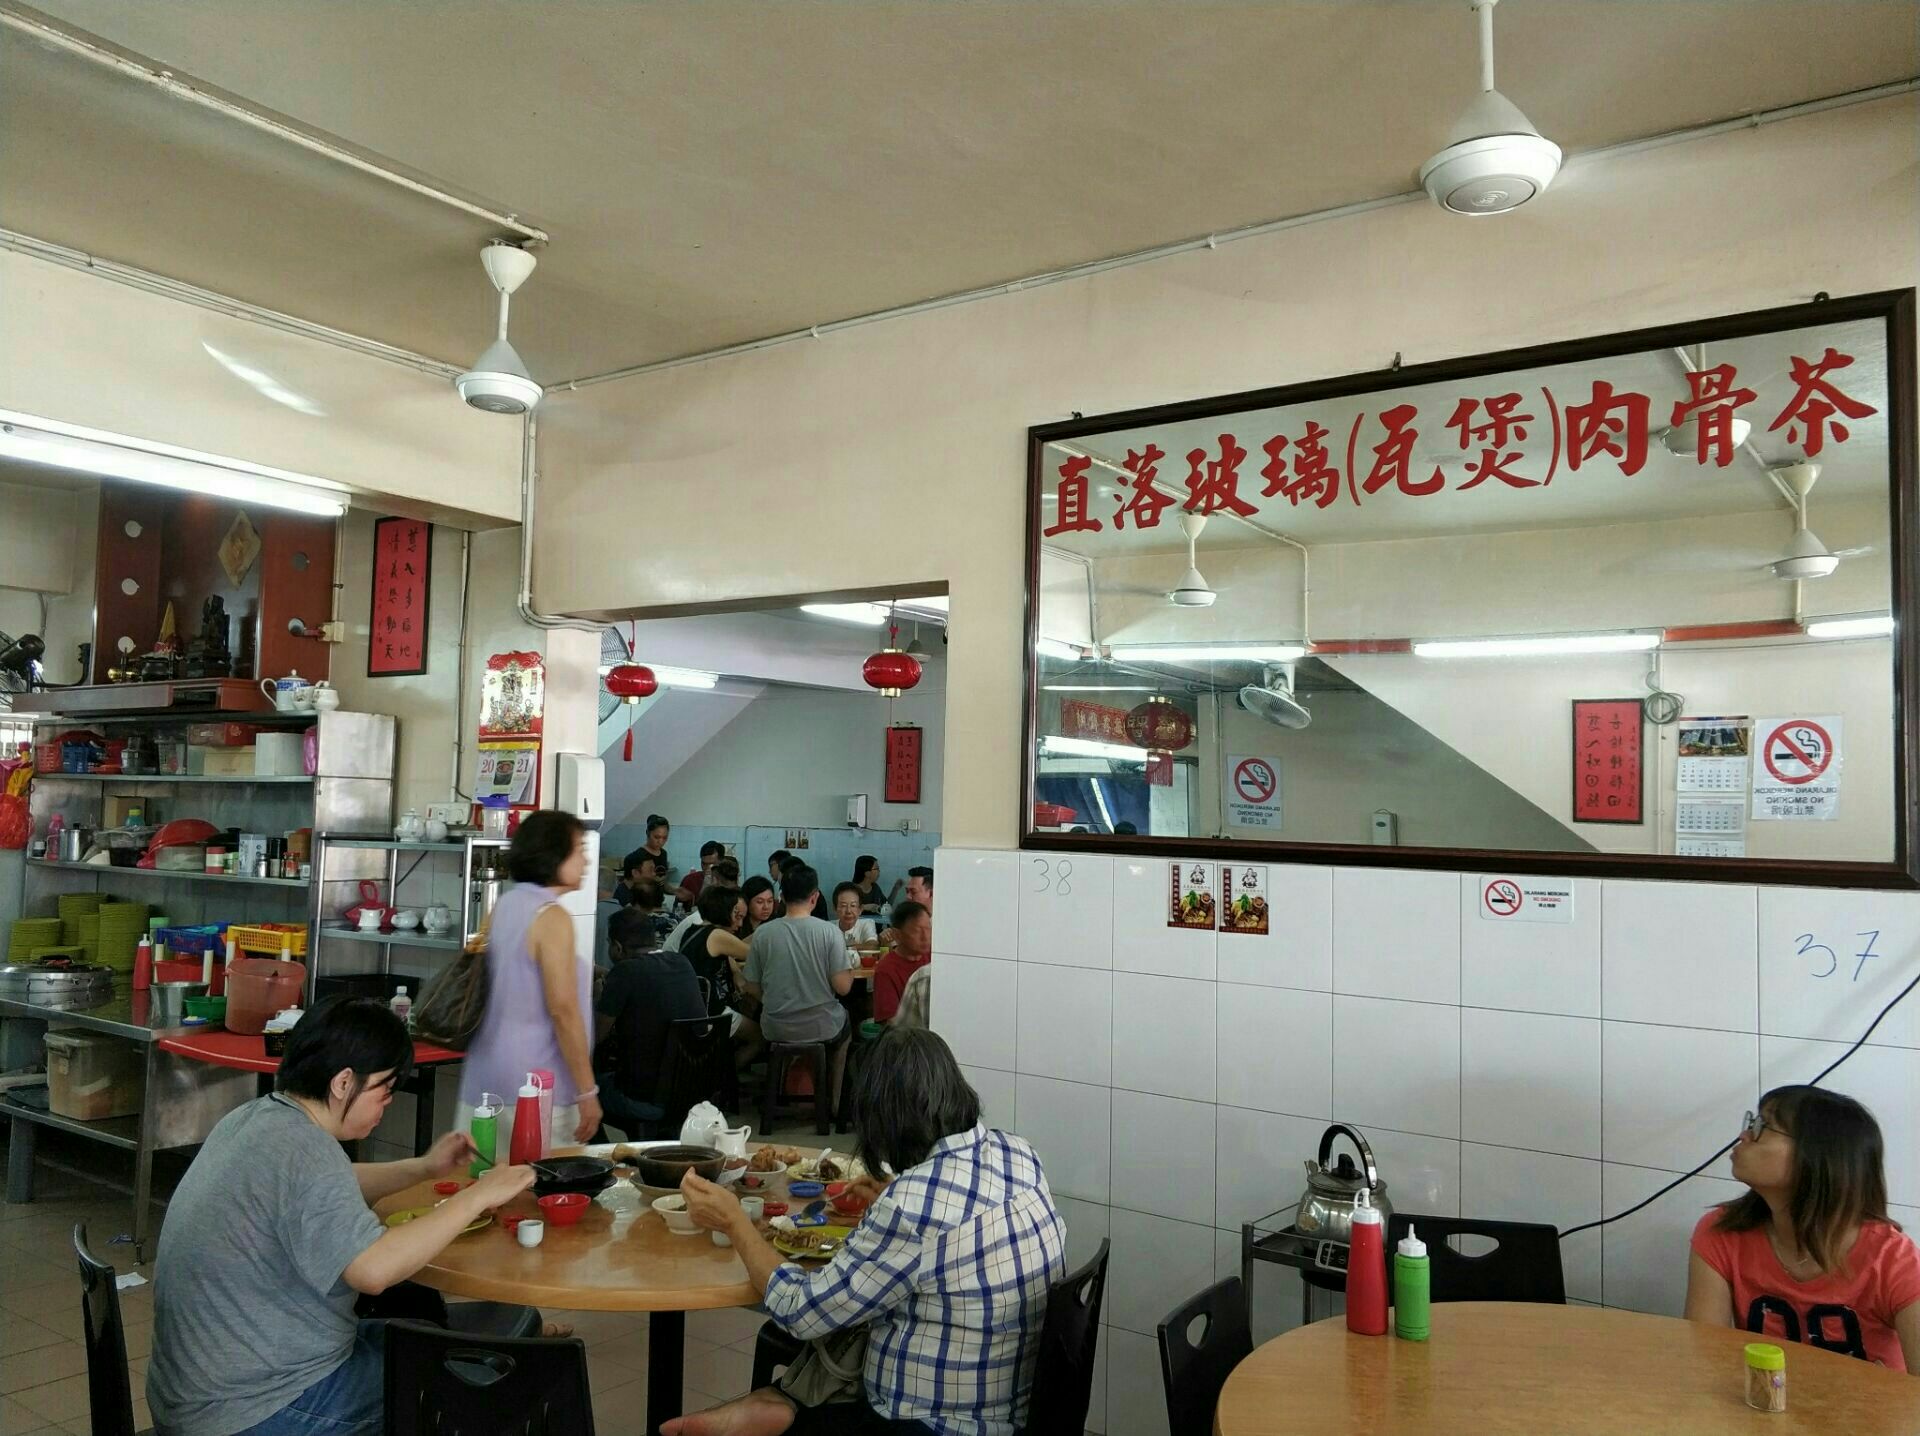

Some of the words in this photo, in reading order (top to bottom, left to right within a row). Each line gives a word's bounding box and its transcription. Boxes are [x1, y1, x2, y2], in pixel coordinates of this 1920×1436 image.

[1044, 347, 1878, 536] 直落玻璃(瓦煲)肉骨茶
[481, 758, 495, 773] 20
[516, 759, 530, 773] 21
[1033, 858, 1073, 896] 38
[1794, 930, 1880, 981] 37
